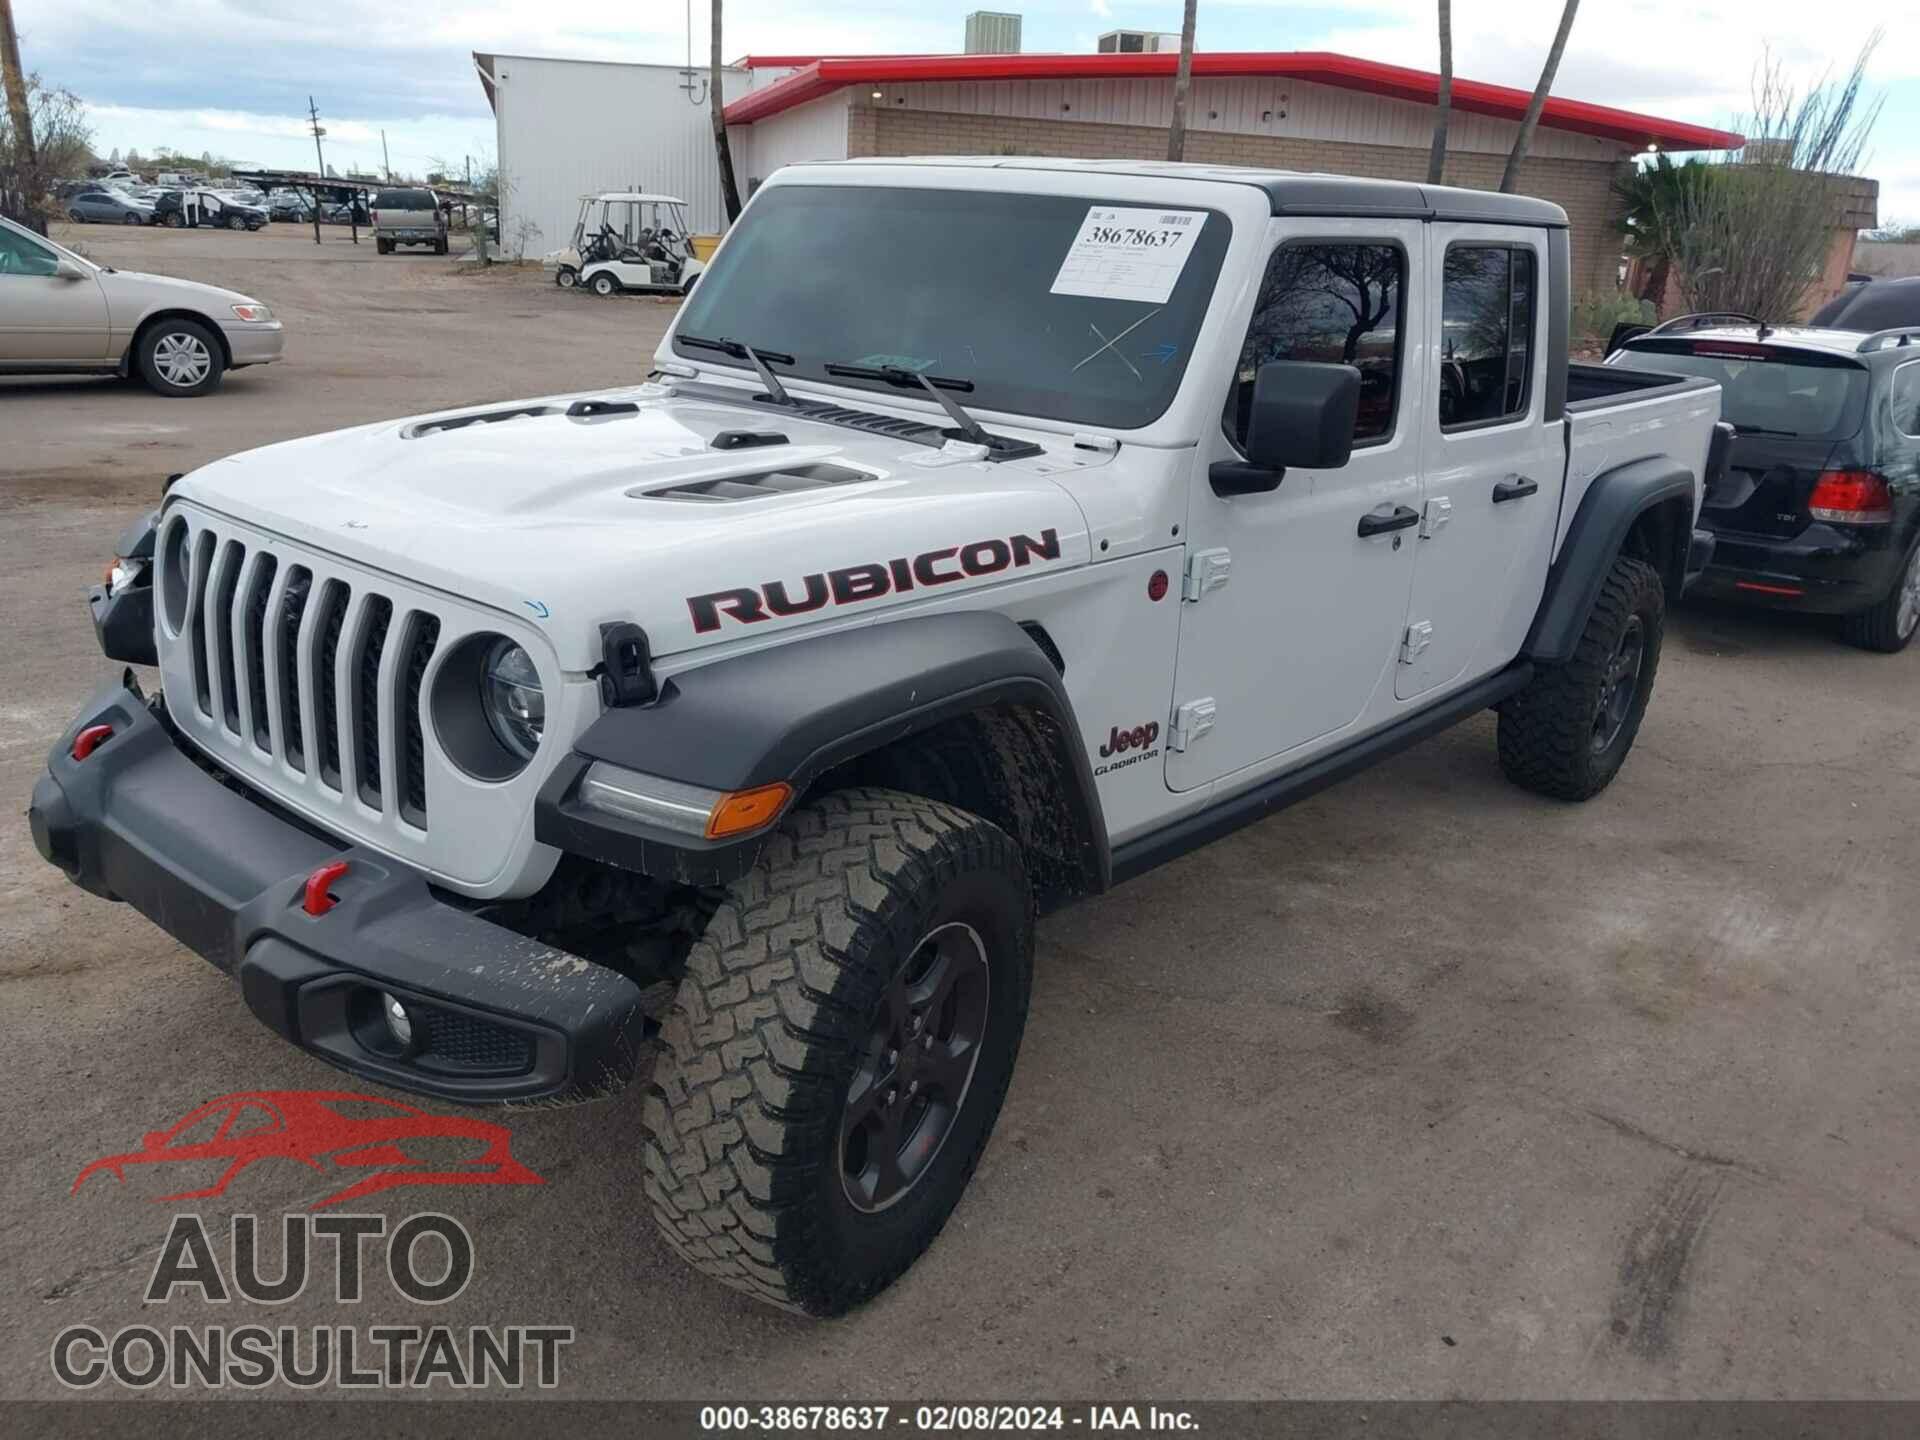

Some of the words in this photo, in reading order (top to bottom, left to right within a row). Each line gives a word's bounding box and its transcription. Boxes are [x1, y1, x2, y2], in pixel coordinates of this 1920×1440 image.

[1086, 226, 1183, 248] 38678637
[686, 528, 1061, 634] RUBICON
[1099, 721, 1159, 758] Jeep
[1094, 749, 1159, 776] GLADIATOR
